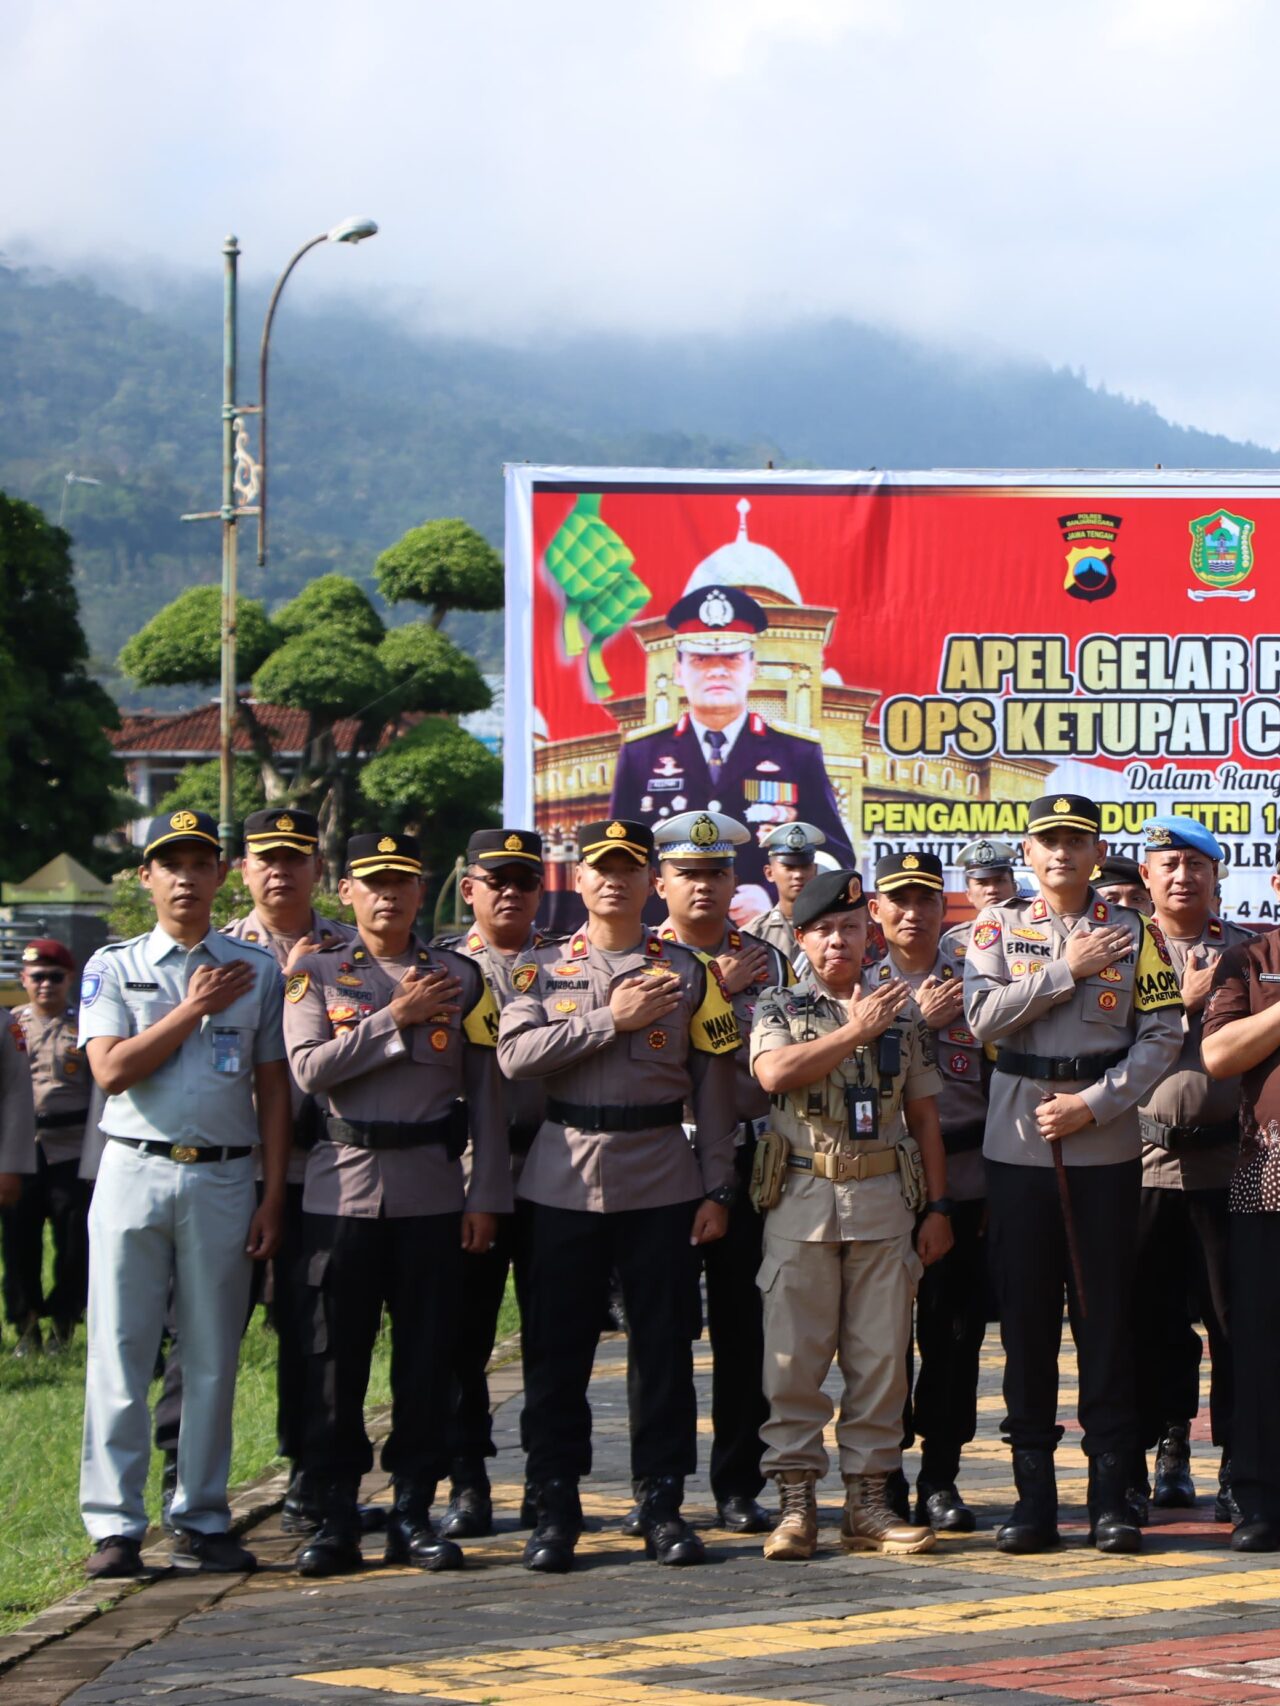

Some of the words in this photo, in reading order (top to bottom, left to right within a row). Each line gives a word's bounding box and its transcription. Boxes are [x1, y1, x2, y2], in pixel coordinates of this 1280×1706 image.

[943, 637, 1073, 692] APEL
[1080, 637, 1248, 692] GELAR
[885, 699, 997, 753] OPS
[1003, 699, 1237, 753] KETUPAT
[1127, 765, 1214, 790] Dalam
[1237, 900, 1251, 918] 4
[1006, 941, 1051, 957] ERICK
